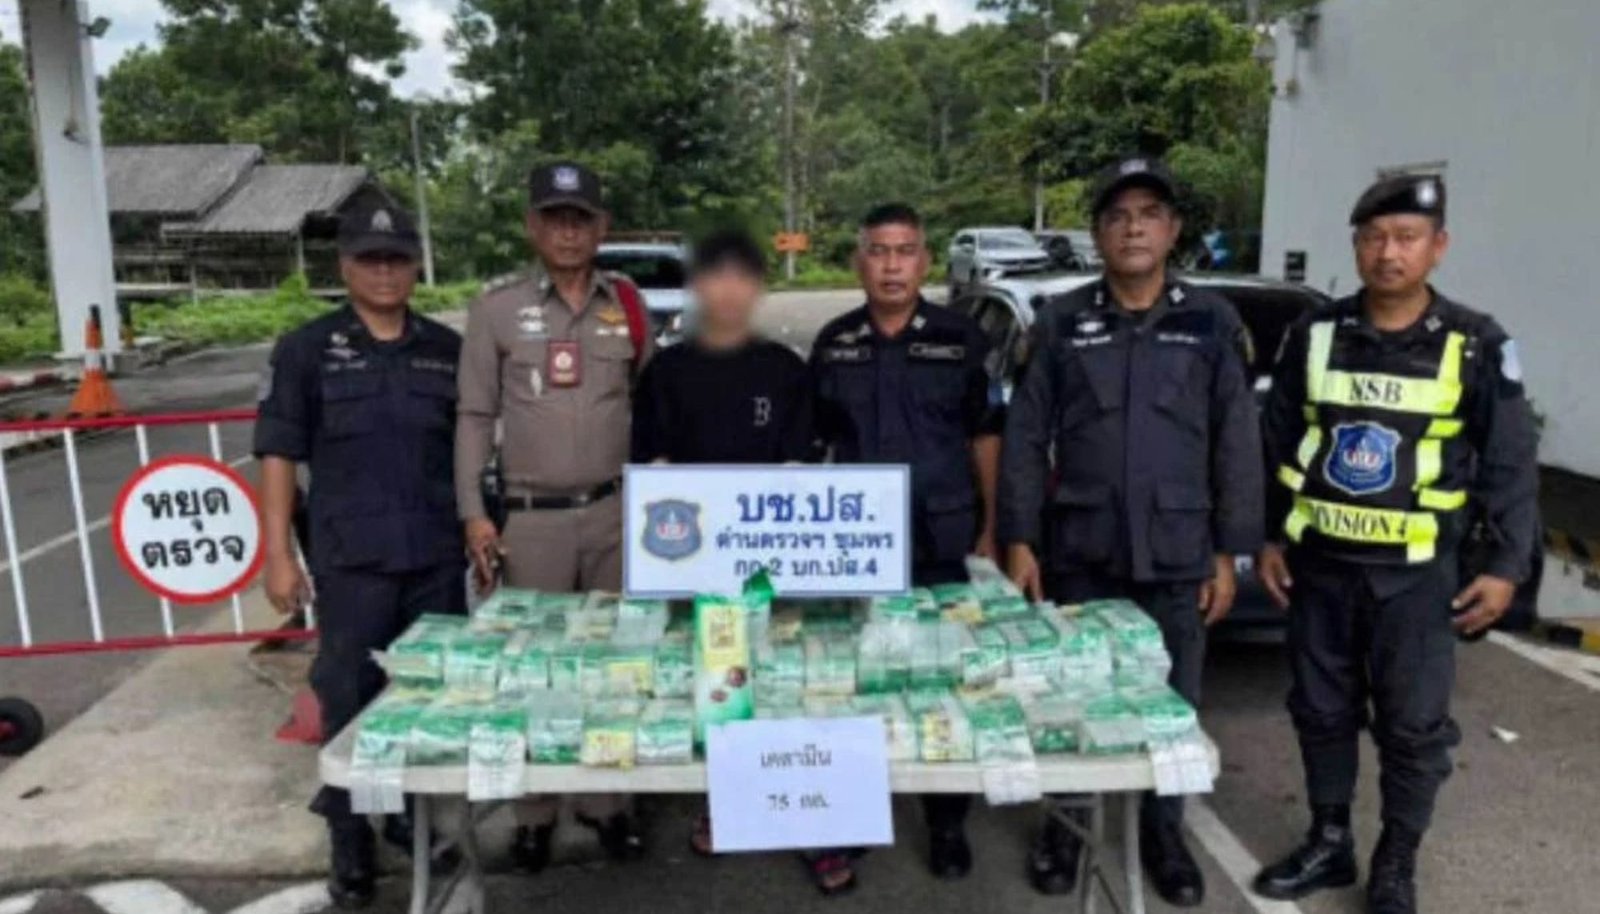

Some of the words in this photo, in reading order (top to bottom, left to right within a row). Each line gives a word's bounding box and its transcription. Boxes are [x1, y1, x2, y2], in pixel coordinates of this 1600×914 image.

[1349, 376, 1402, 404] NSB
[142, 486, 230, 532] หยุด
[737, 485, 876, 523] บช.ปส.
[141, 535, 245, 568] ตรวจ
[834, 530, 894, 556] ชุมพร
[767, 794, 790, 811] 75
